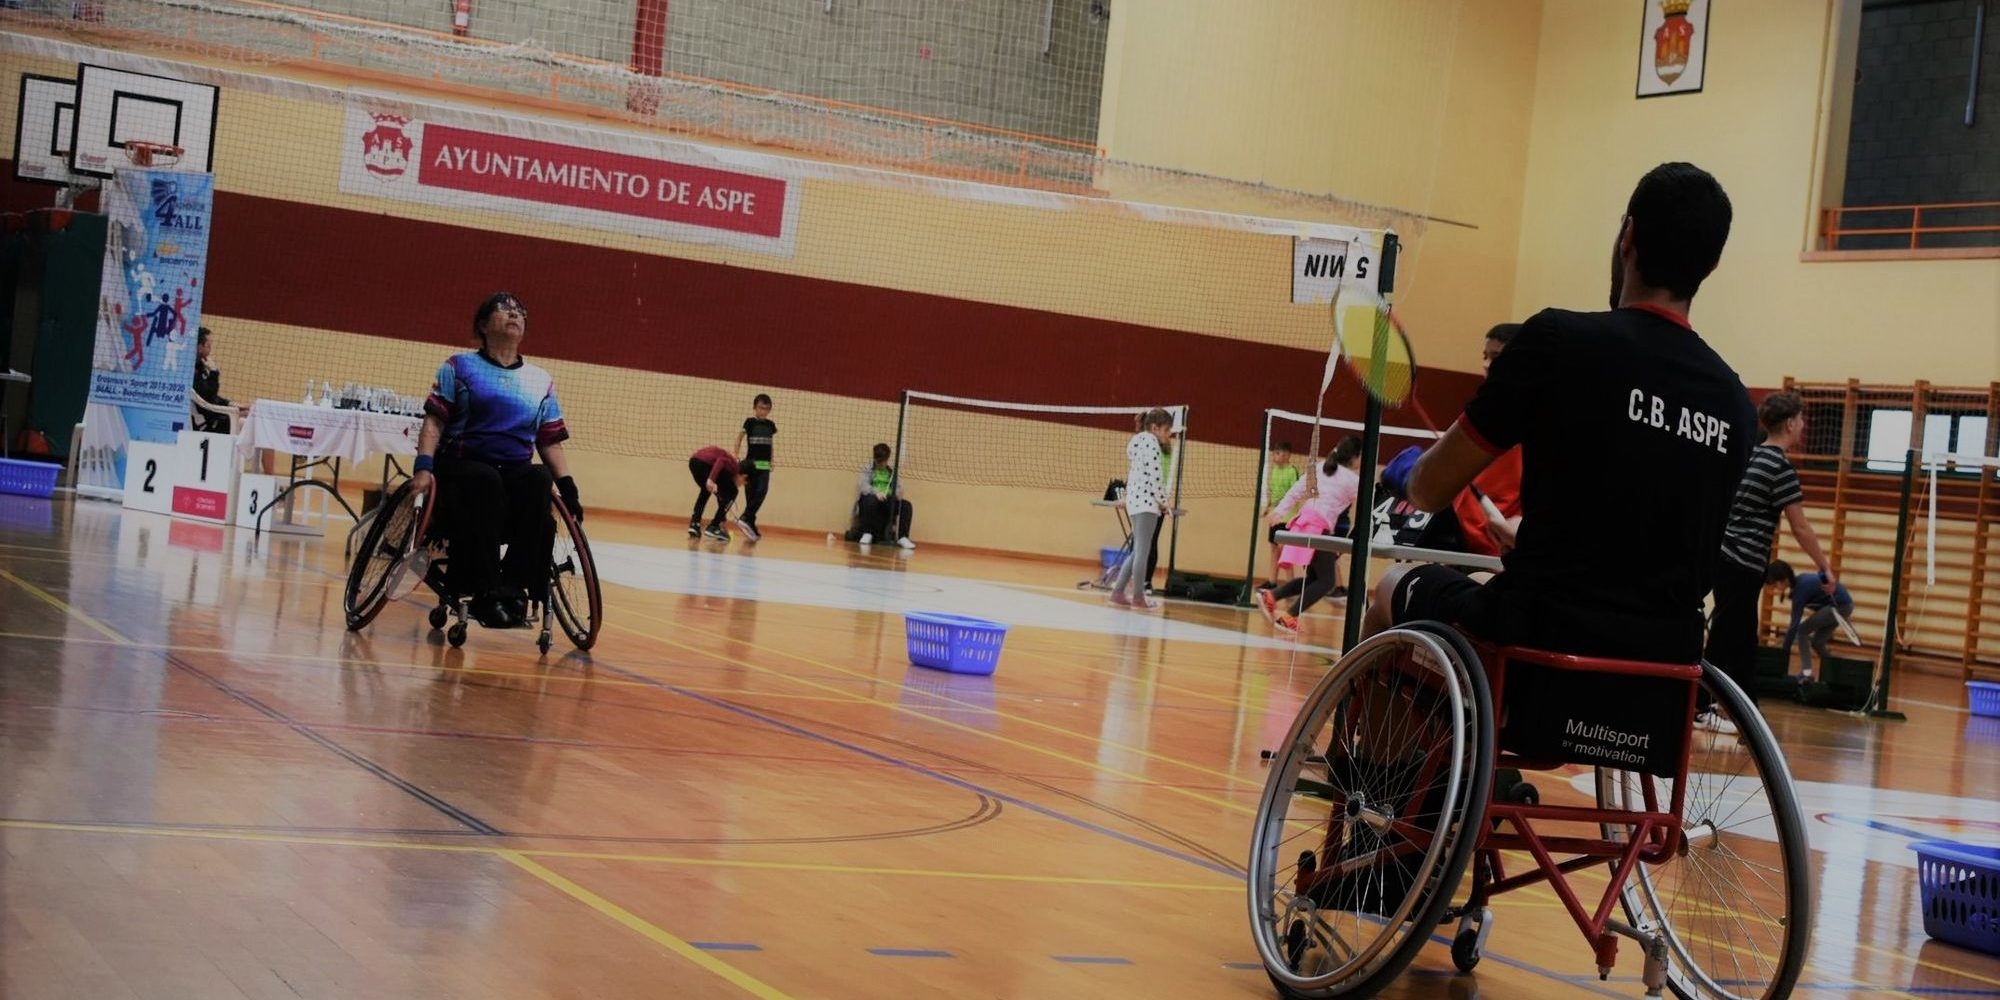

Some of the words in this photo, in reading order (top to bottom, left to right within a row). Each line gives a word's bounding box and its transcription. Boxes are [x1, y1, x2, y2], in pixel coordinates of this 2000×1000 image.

[434, 144, 650, 199] AYUNTAMIENTO
[657, 179, 690, 205] DE
[697, 185, 756, 216] ASPE
[1304, 254, 1344, 278] MIN
[1355, 256, 1370, 279] 5
[1628, 387, 1671, 432] C.B.
[1676, 406, 1731, 455] ASPE
[200, 438, 209, 481] 1
[143, 459, 157, 493] 2
[249, 490, 258, 514] 3
[1565, 718, 1650, 749] Multisport
[1574, 743, 1646, 765] motivation
